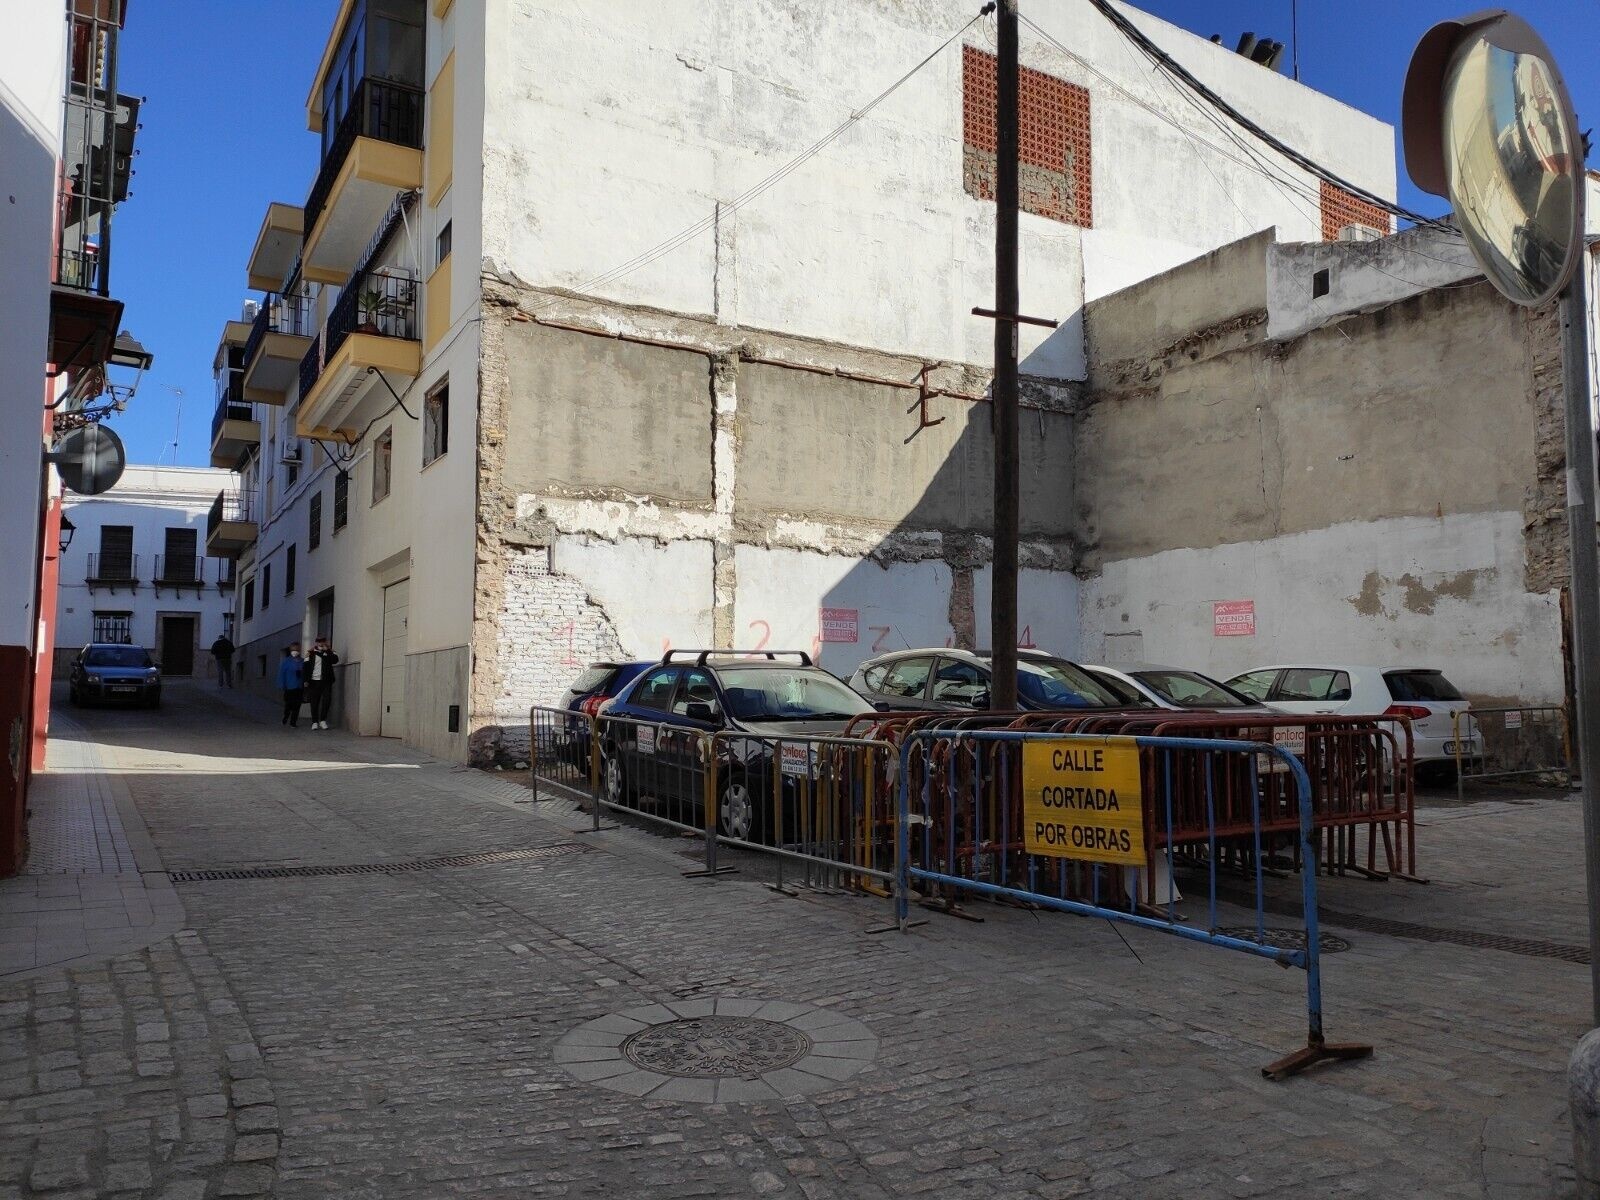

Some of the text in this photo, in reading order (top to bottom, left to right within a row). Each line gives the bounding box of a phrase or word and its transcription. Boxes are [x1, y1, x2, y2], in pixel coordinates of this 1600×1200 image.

[823, 621, 855, 629] VENDE
[1218, 614, 1252, 623] VENDE
[1275, 728, 1305, 741] antora
[1052, 750, 1104, 772] CALLE
[1042, 786, 1120, 811] CORTADA
[1035, 822, 1131, 852] POR OBRAS
